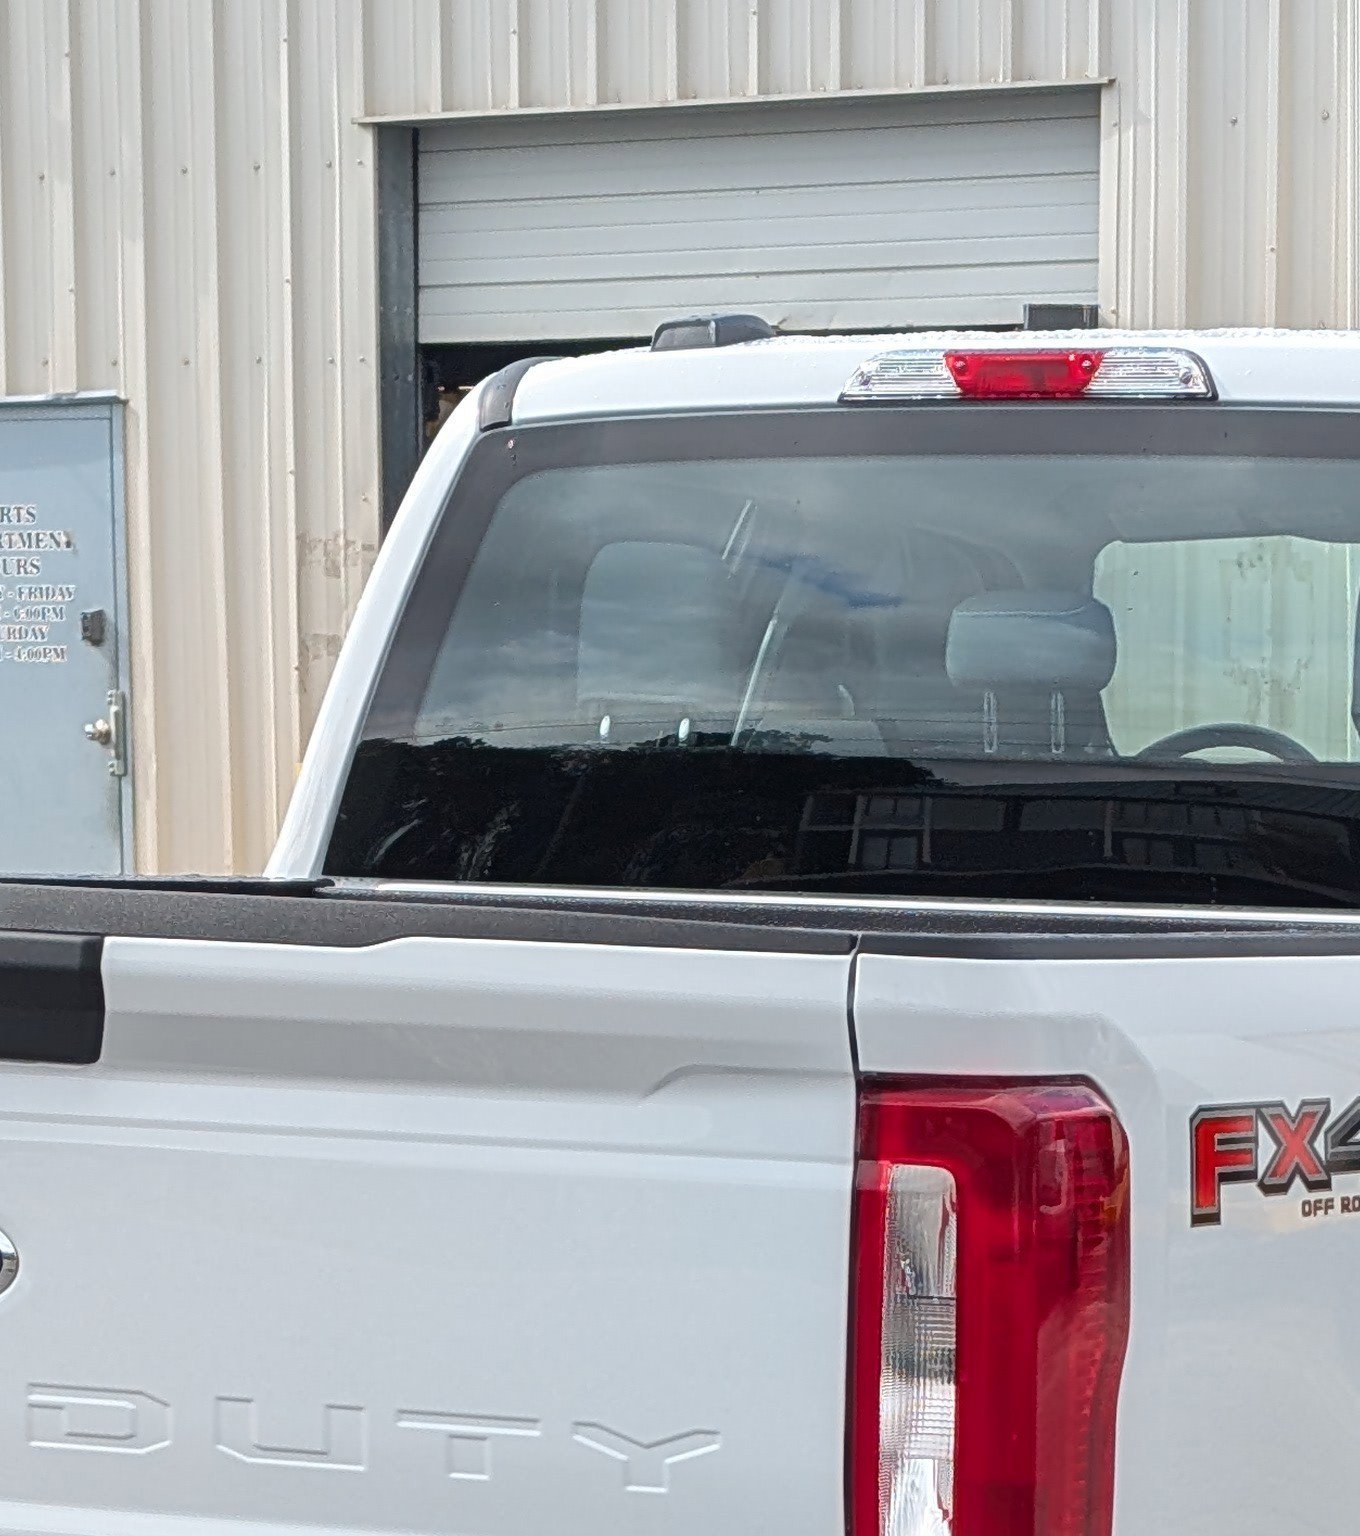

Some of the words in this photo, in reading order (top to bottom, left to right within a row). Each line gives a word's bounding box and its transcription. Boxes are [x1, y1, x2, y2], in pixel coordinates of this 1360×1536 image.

[16, 584, 76, 601] FRIDAY
[1301, 1199, 1335, 1217] OFF
[26, 1381, 722, 1493] DUTY
